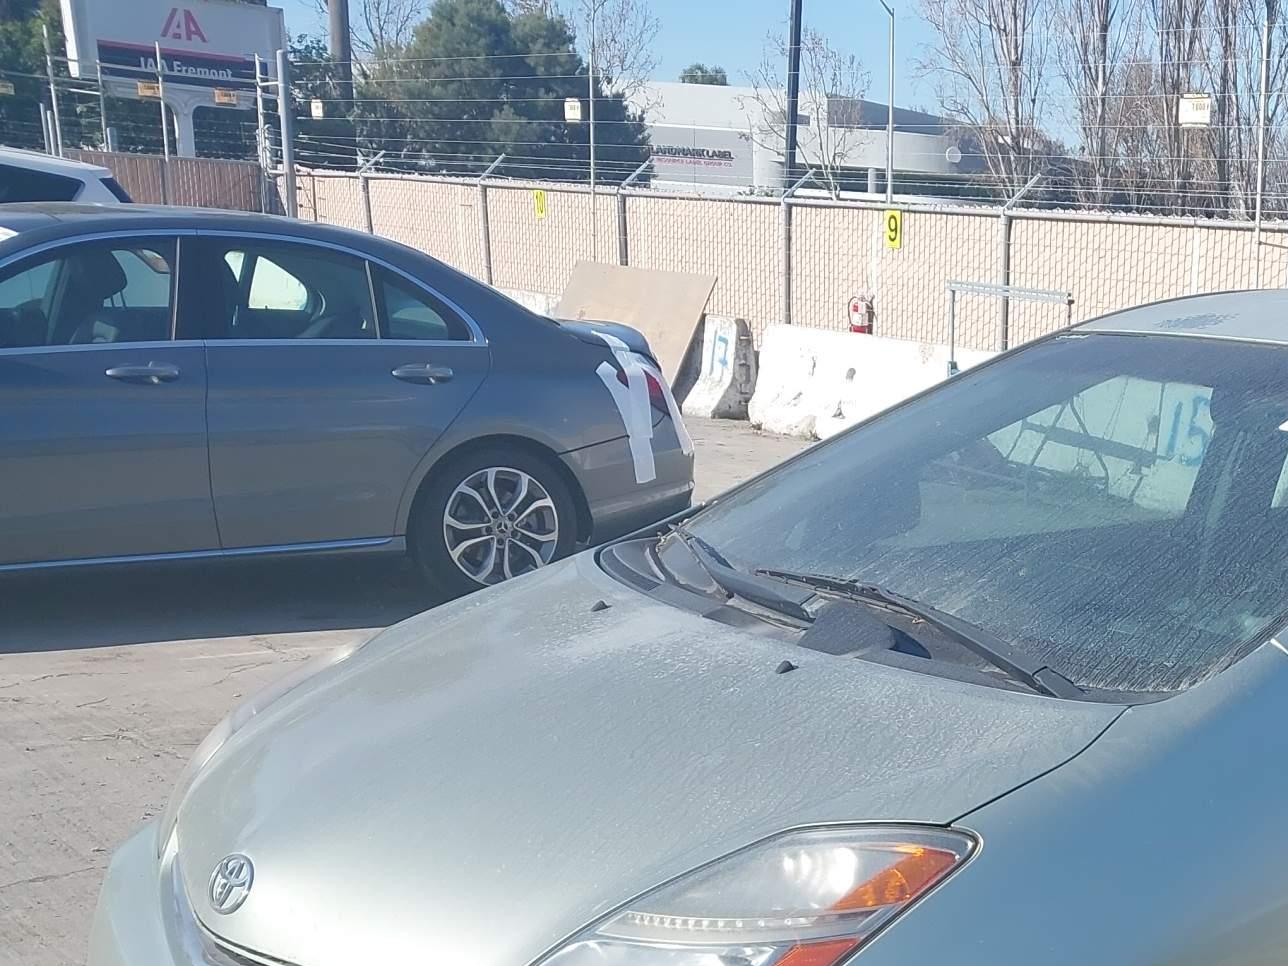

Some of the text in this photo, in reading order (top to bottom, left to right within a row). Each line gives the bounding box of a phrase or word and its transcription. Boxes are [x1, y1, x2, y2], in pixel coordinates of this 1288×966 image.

[173, 61, 232, 79] Fremont
[650, 144, 734, 160] LANDMARK LABEL
[888, 214, 898, 242] 9
